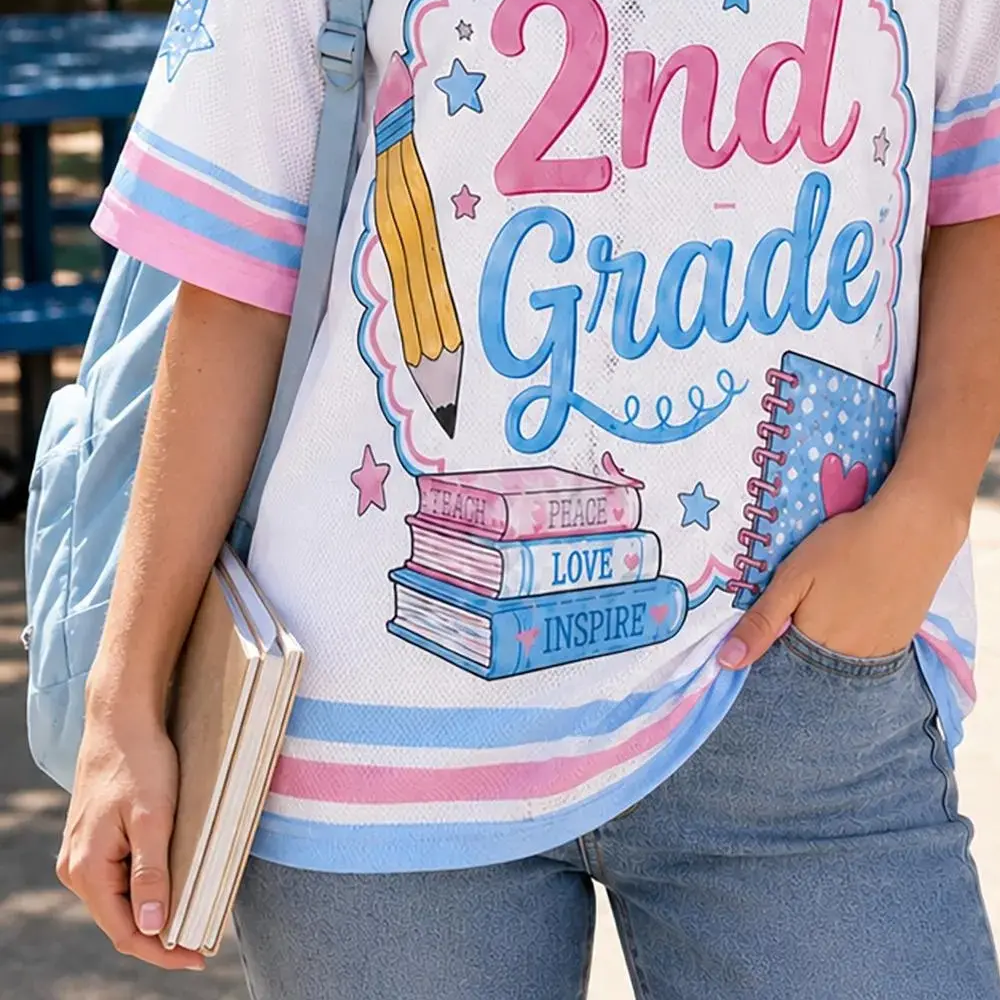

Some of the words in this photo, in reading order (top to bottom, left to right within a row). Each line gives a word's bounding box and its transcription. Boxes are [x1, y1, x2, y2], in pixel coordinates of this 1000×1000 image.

[478, 172, 880, 455] Grade
[548, 497, 608, 529] PEACE
[551, 547, 614, 586] LOVE
[542, 602, 647, 654] INSPIRE
